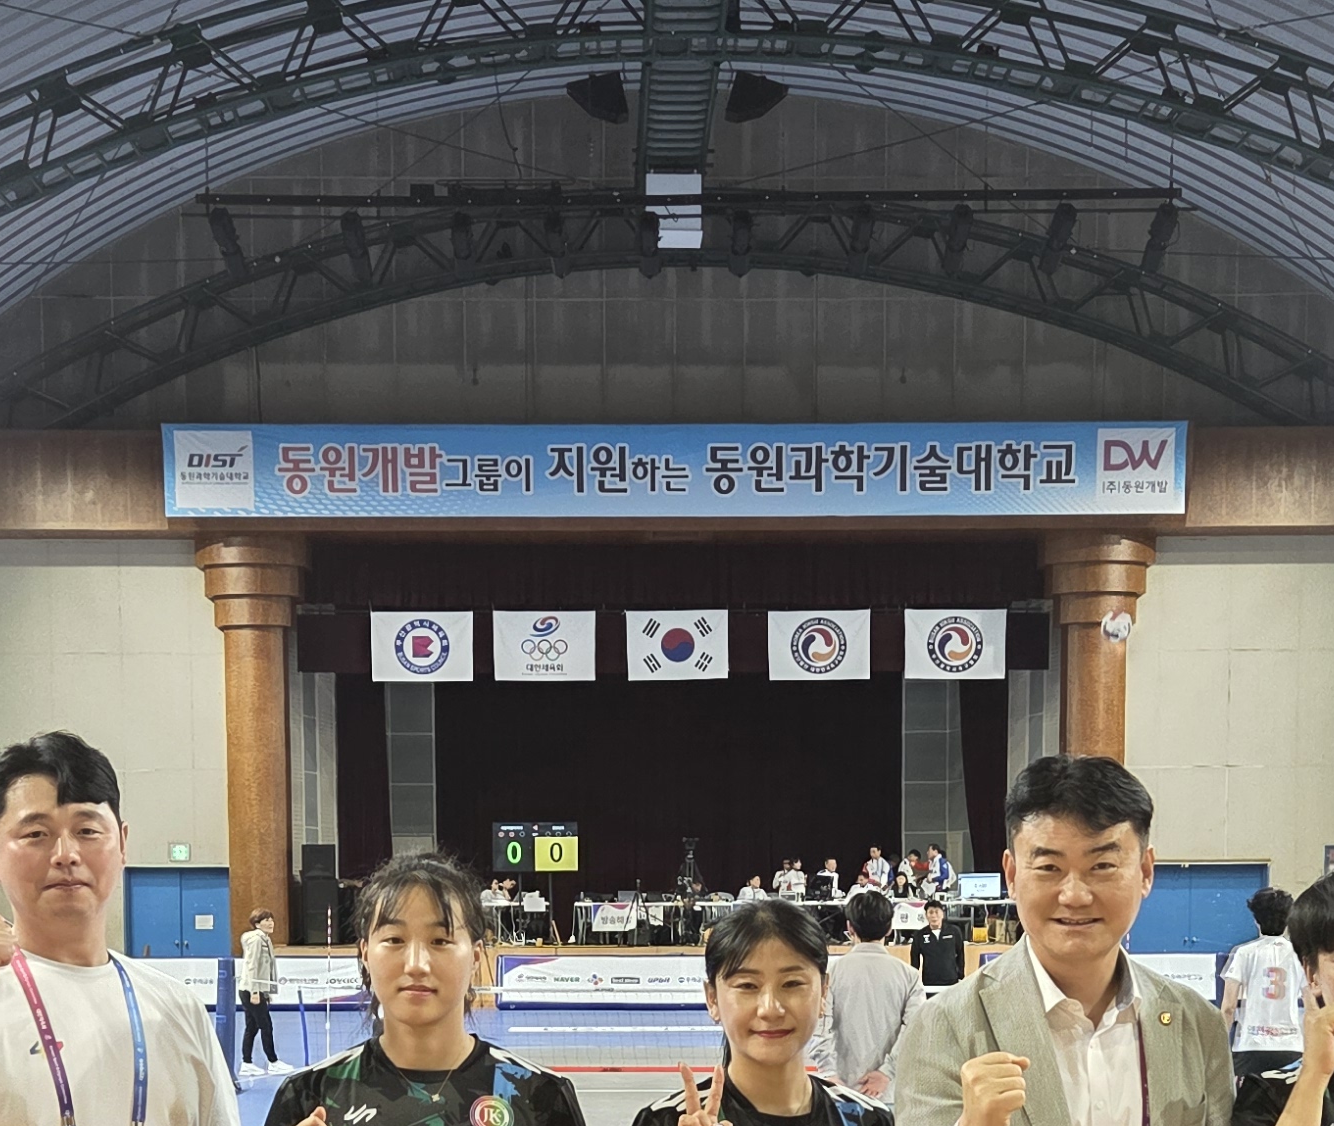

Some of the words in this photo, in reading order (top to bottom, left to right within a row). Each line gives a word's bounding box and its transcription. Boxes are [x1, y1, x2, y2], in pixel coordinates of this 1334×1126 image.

[187, 453, 244, 468] DIST
[1103, 439, 1168, 471] DW
[180, 471, 249, 481] 동원과학기술대학교
[278, 444, 533, 494] 동원개발그룹이
[548, 445, 689, 494] 지원하는
[705, 442, 1076, 494] 동원과학기술대학교
[506, 841, 522, 864] 0
[549, 842, 563, 863] 0
[1262, 966, 1287, 1000] 3
